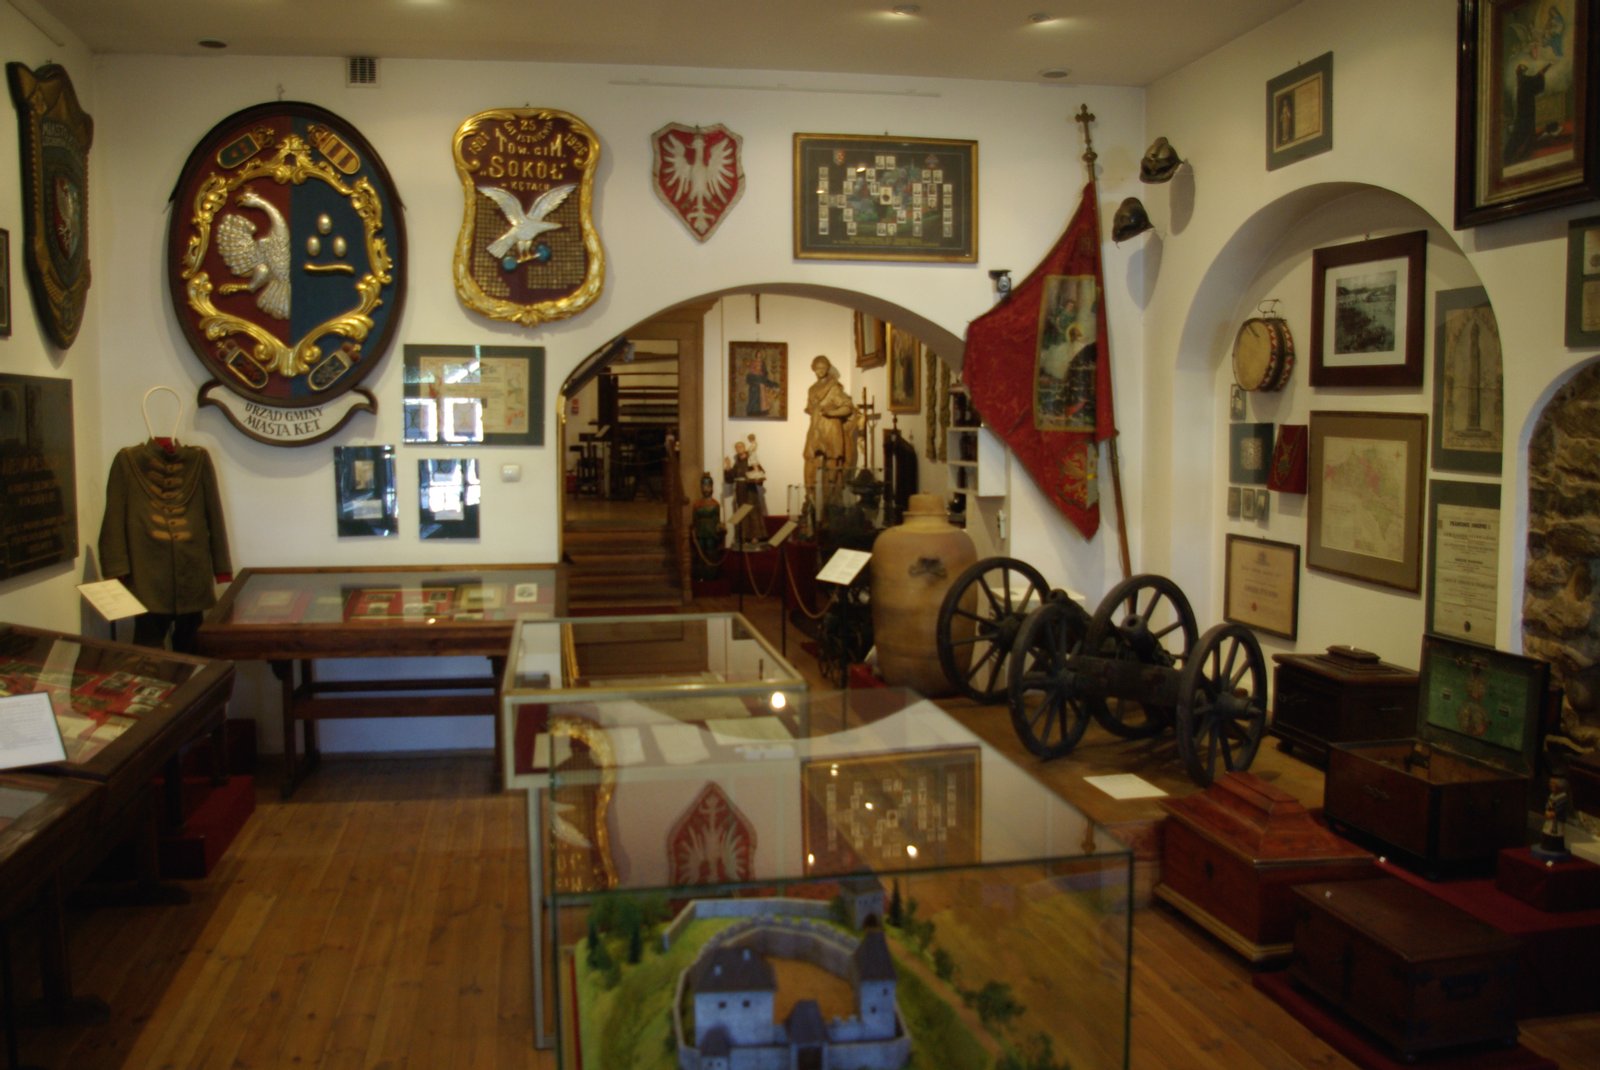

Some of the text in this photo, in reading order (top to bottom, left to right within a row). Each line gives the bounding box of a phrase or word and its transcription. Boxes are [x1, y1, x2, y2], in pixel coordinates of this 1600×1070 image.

[520, 119, 536, 131] 25
[285, 407, 324, 421] GMINY
[243, 415, 291, 436] MIASTA
